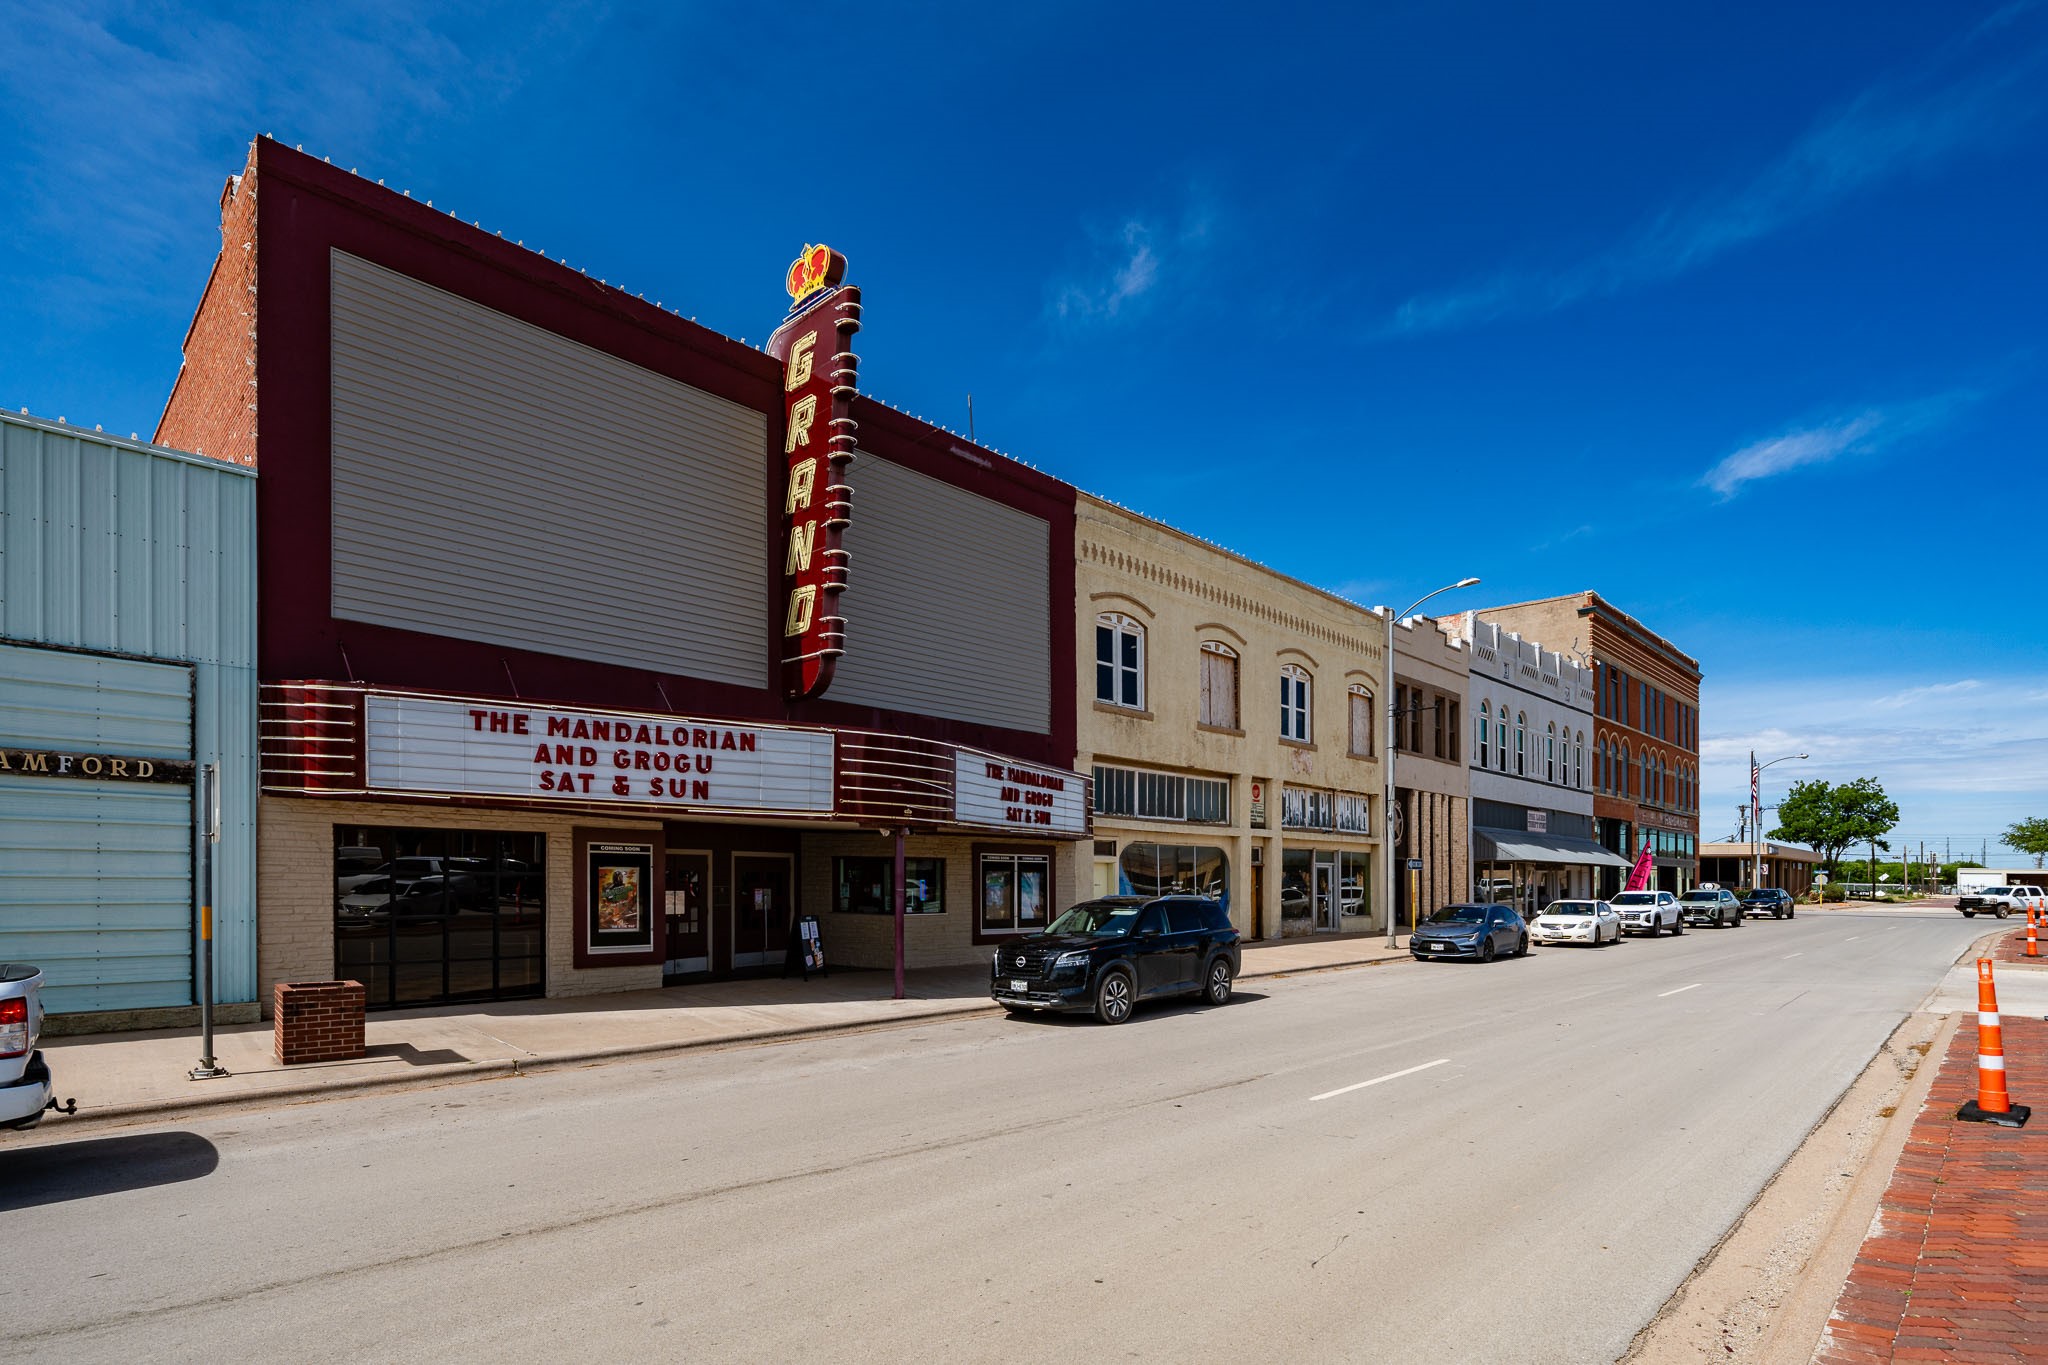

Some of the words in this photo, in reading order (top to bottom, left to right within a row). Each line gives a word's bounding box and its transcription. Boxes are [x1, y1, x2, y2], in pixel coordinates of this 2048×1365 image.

[785, 330, 817, 638] GRAND
[469, 710, 529, 735] THE
[547, 716, 756, 752] MANDALORIAN
[534, 743, 598, 767] AND
[613, 749, 713, 774] GROGU
[538, 770, 595, 794] SAT
[612, 775, 630, 796] &
[648, 777, 709, 800] SUN
[985, 762, 1005, 781] THE
[1007, 766, 1064, 791] MANDALORIAN
[1001, 786, 1020, 802] AND
[1024, 790, 1053, 807] GROGU
[1006, 806, 1024, 822] SAT
[1025, 809, 1032, 824] &
[1034, 810, 1051, 825] SUN
